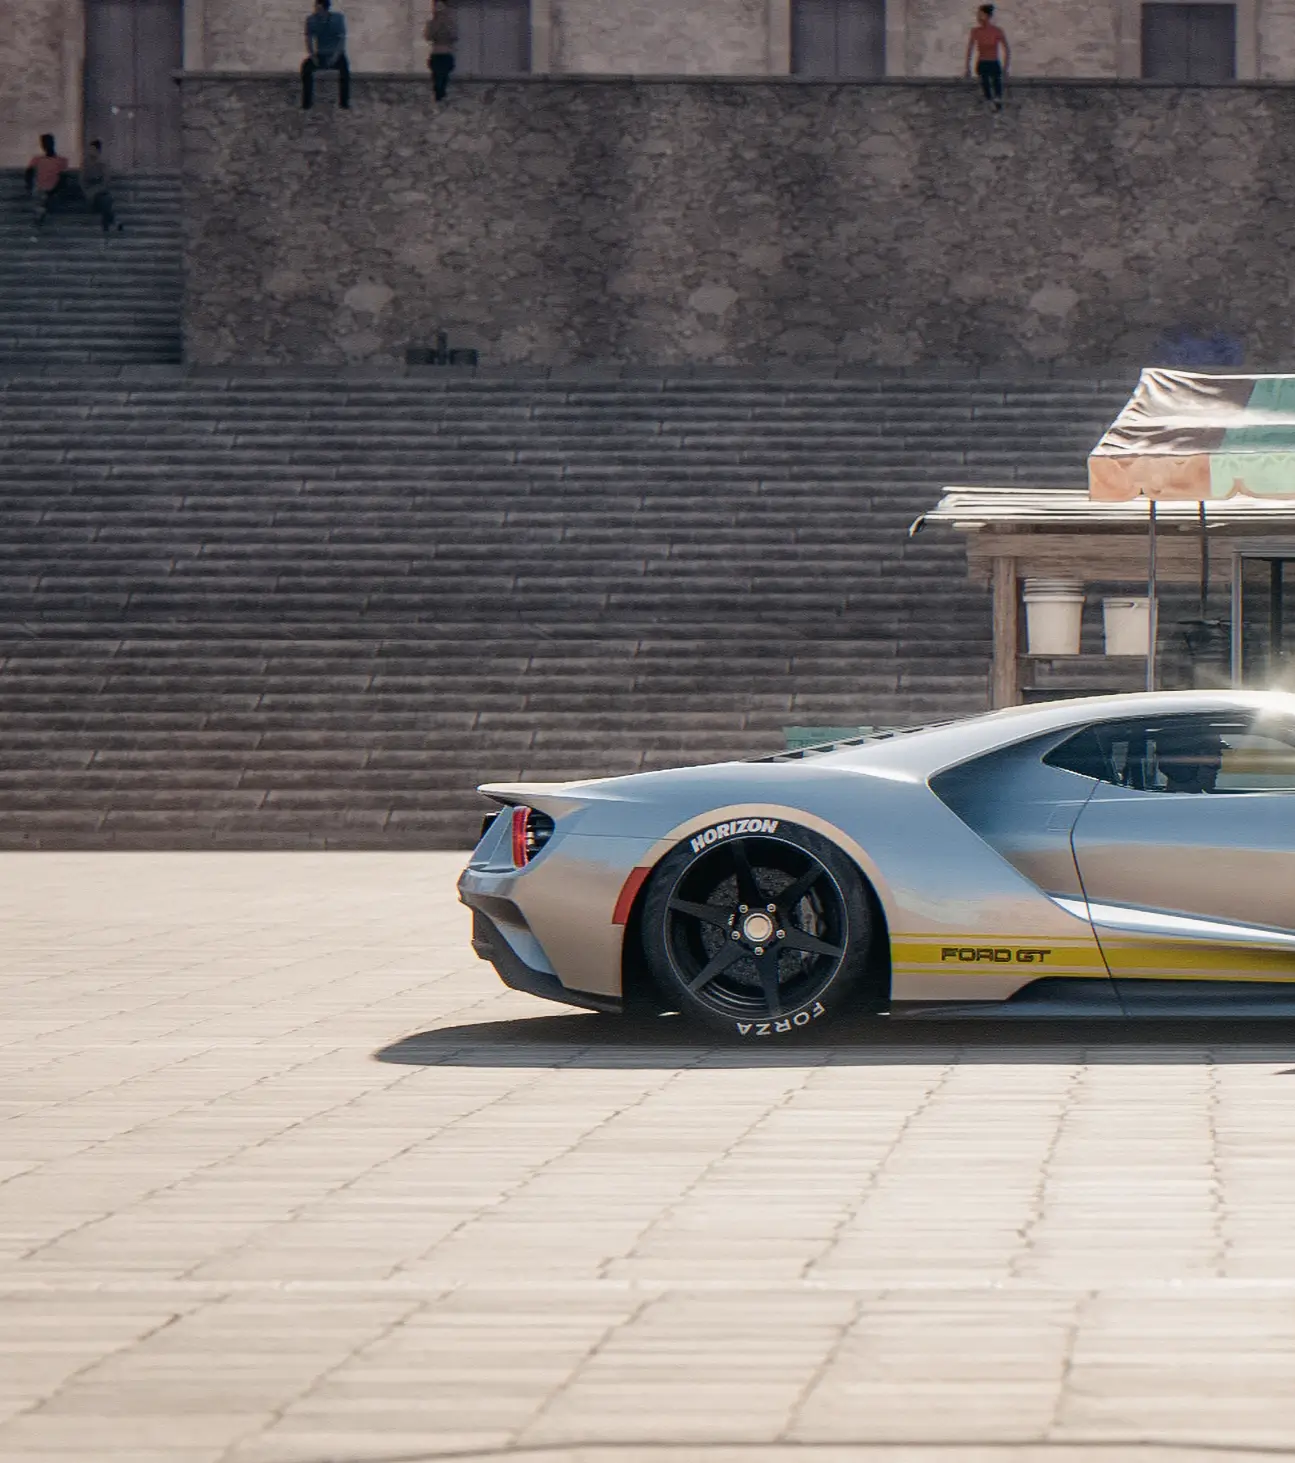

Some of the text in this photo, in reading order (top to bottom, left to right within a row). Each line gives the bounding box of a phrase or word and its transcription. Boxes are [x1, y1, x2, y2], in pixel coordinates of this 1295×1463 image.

[690, 819, 779, 853] HORIZON
[941, 947, 1052, 963] FORD GT
[736, 1002, 826, 1036] FORZA
